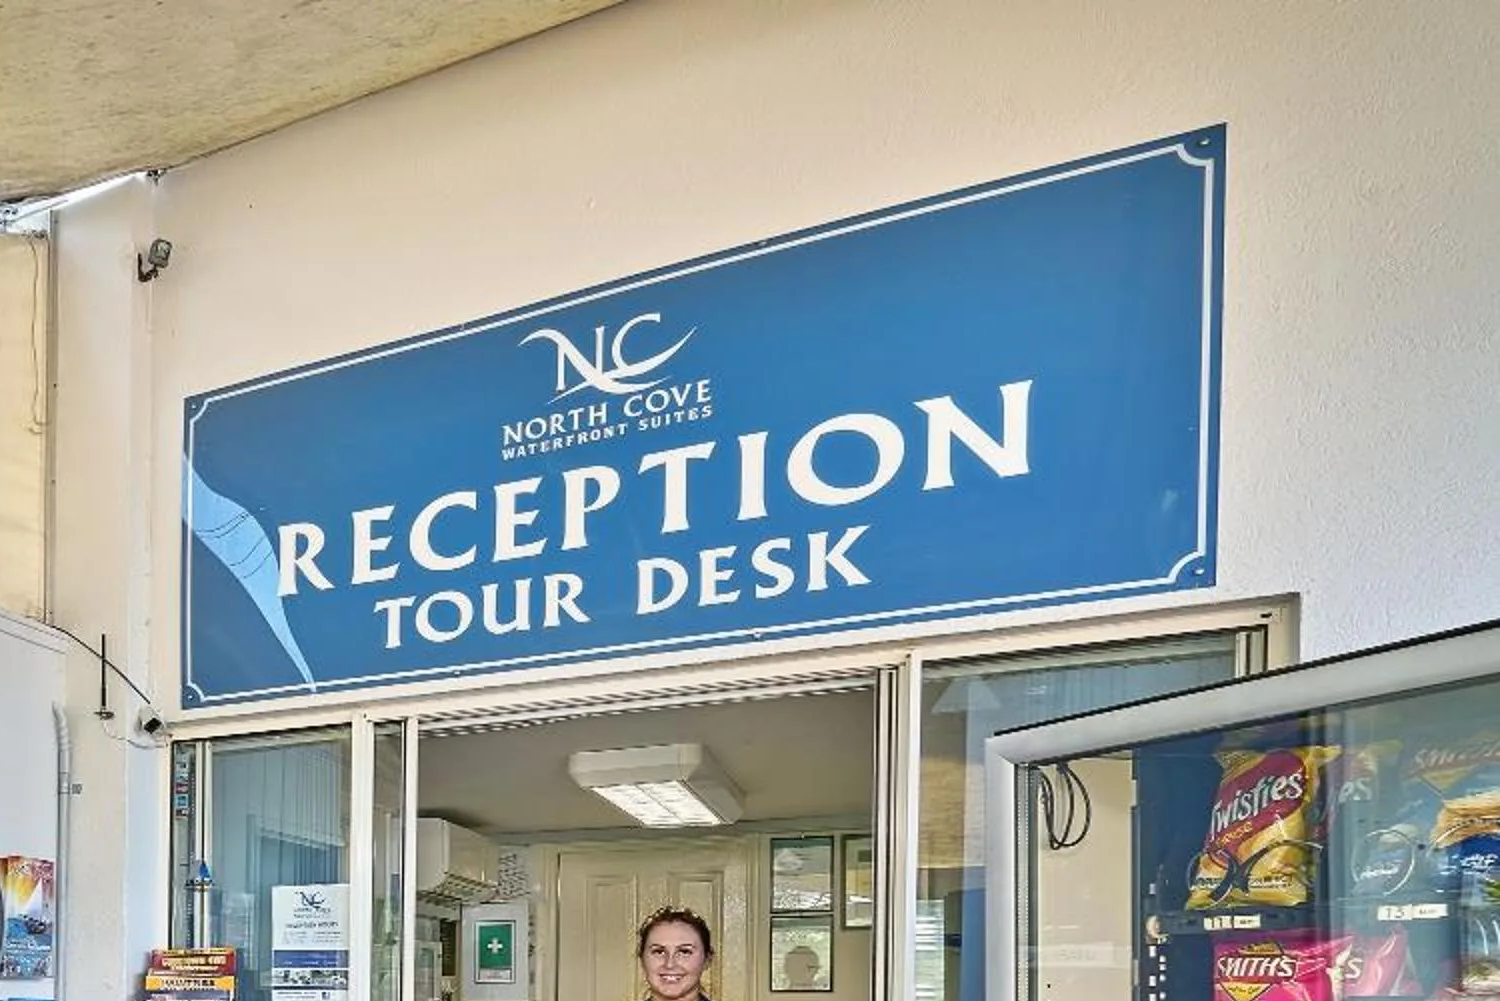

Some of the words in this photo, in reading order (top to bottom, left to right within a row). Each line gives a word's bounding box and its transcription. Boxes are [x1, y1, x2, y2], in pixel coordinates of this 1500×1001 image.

[500, 421, 628, 462] WATERFRONT
[637, 403, 713, 432] SUITES
[501, 399, 609, 447] NORTH
[623, 377, 713, 419] COVE
[276, 379, 1034, 598] RECEPTION
[373, 570, 587, 652] TOUR
[635, 523, 874, 617] DESK
[1208, 767, 1306, 842] Twisties
